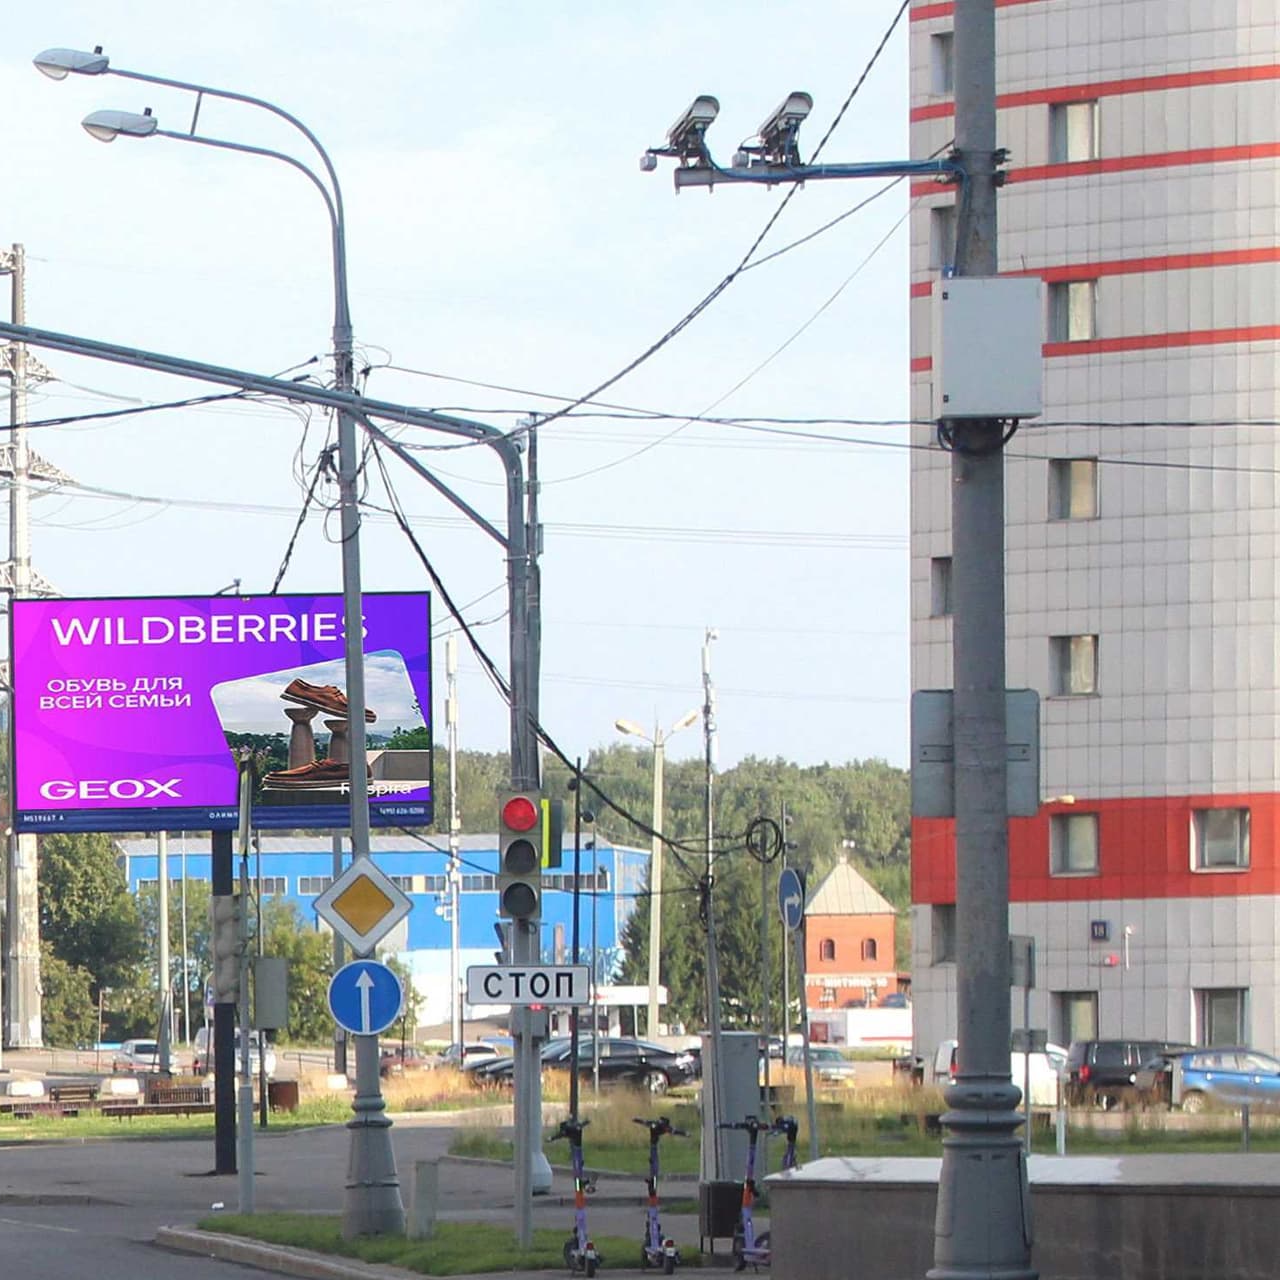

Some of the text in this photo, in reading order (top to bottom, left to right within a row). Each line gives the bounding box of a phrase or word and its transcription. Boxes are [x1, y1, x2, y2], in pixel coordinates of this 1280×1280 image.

[46, 676, 184, 694] ОБУВЬ ДЛЯ
[39, 692, 192, 710] ВСЕЙ СЕМЬИ
[40, 778, 183, 801] GEOX
[340, 782, 412, 798] Rspira
[483, 971, 574, 998] СТОП
